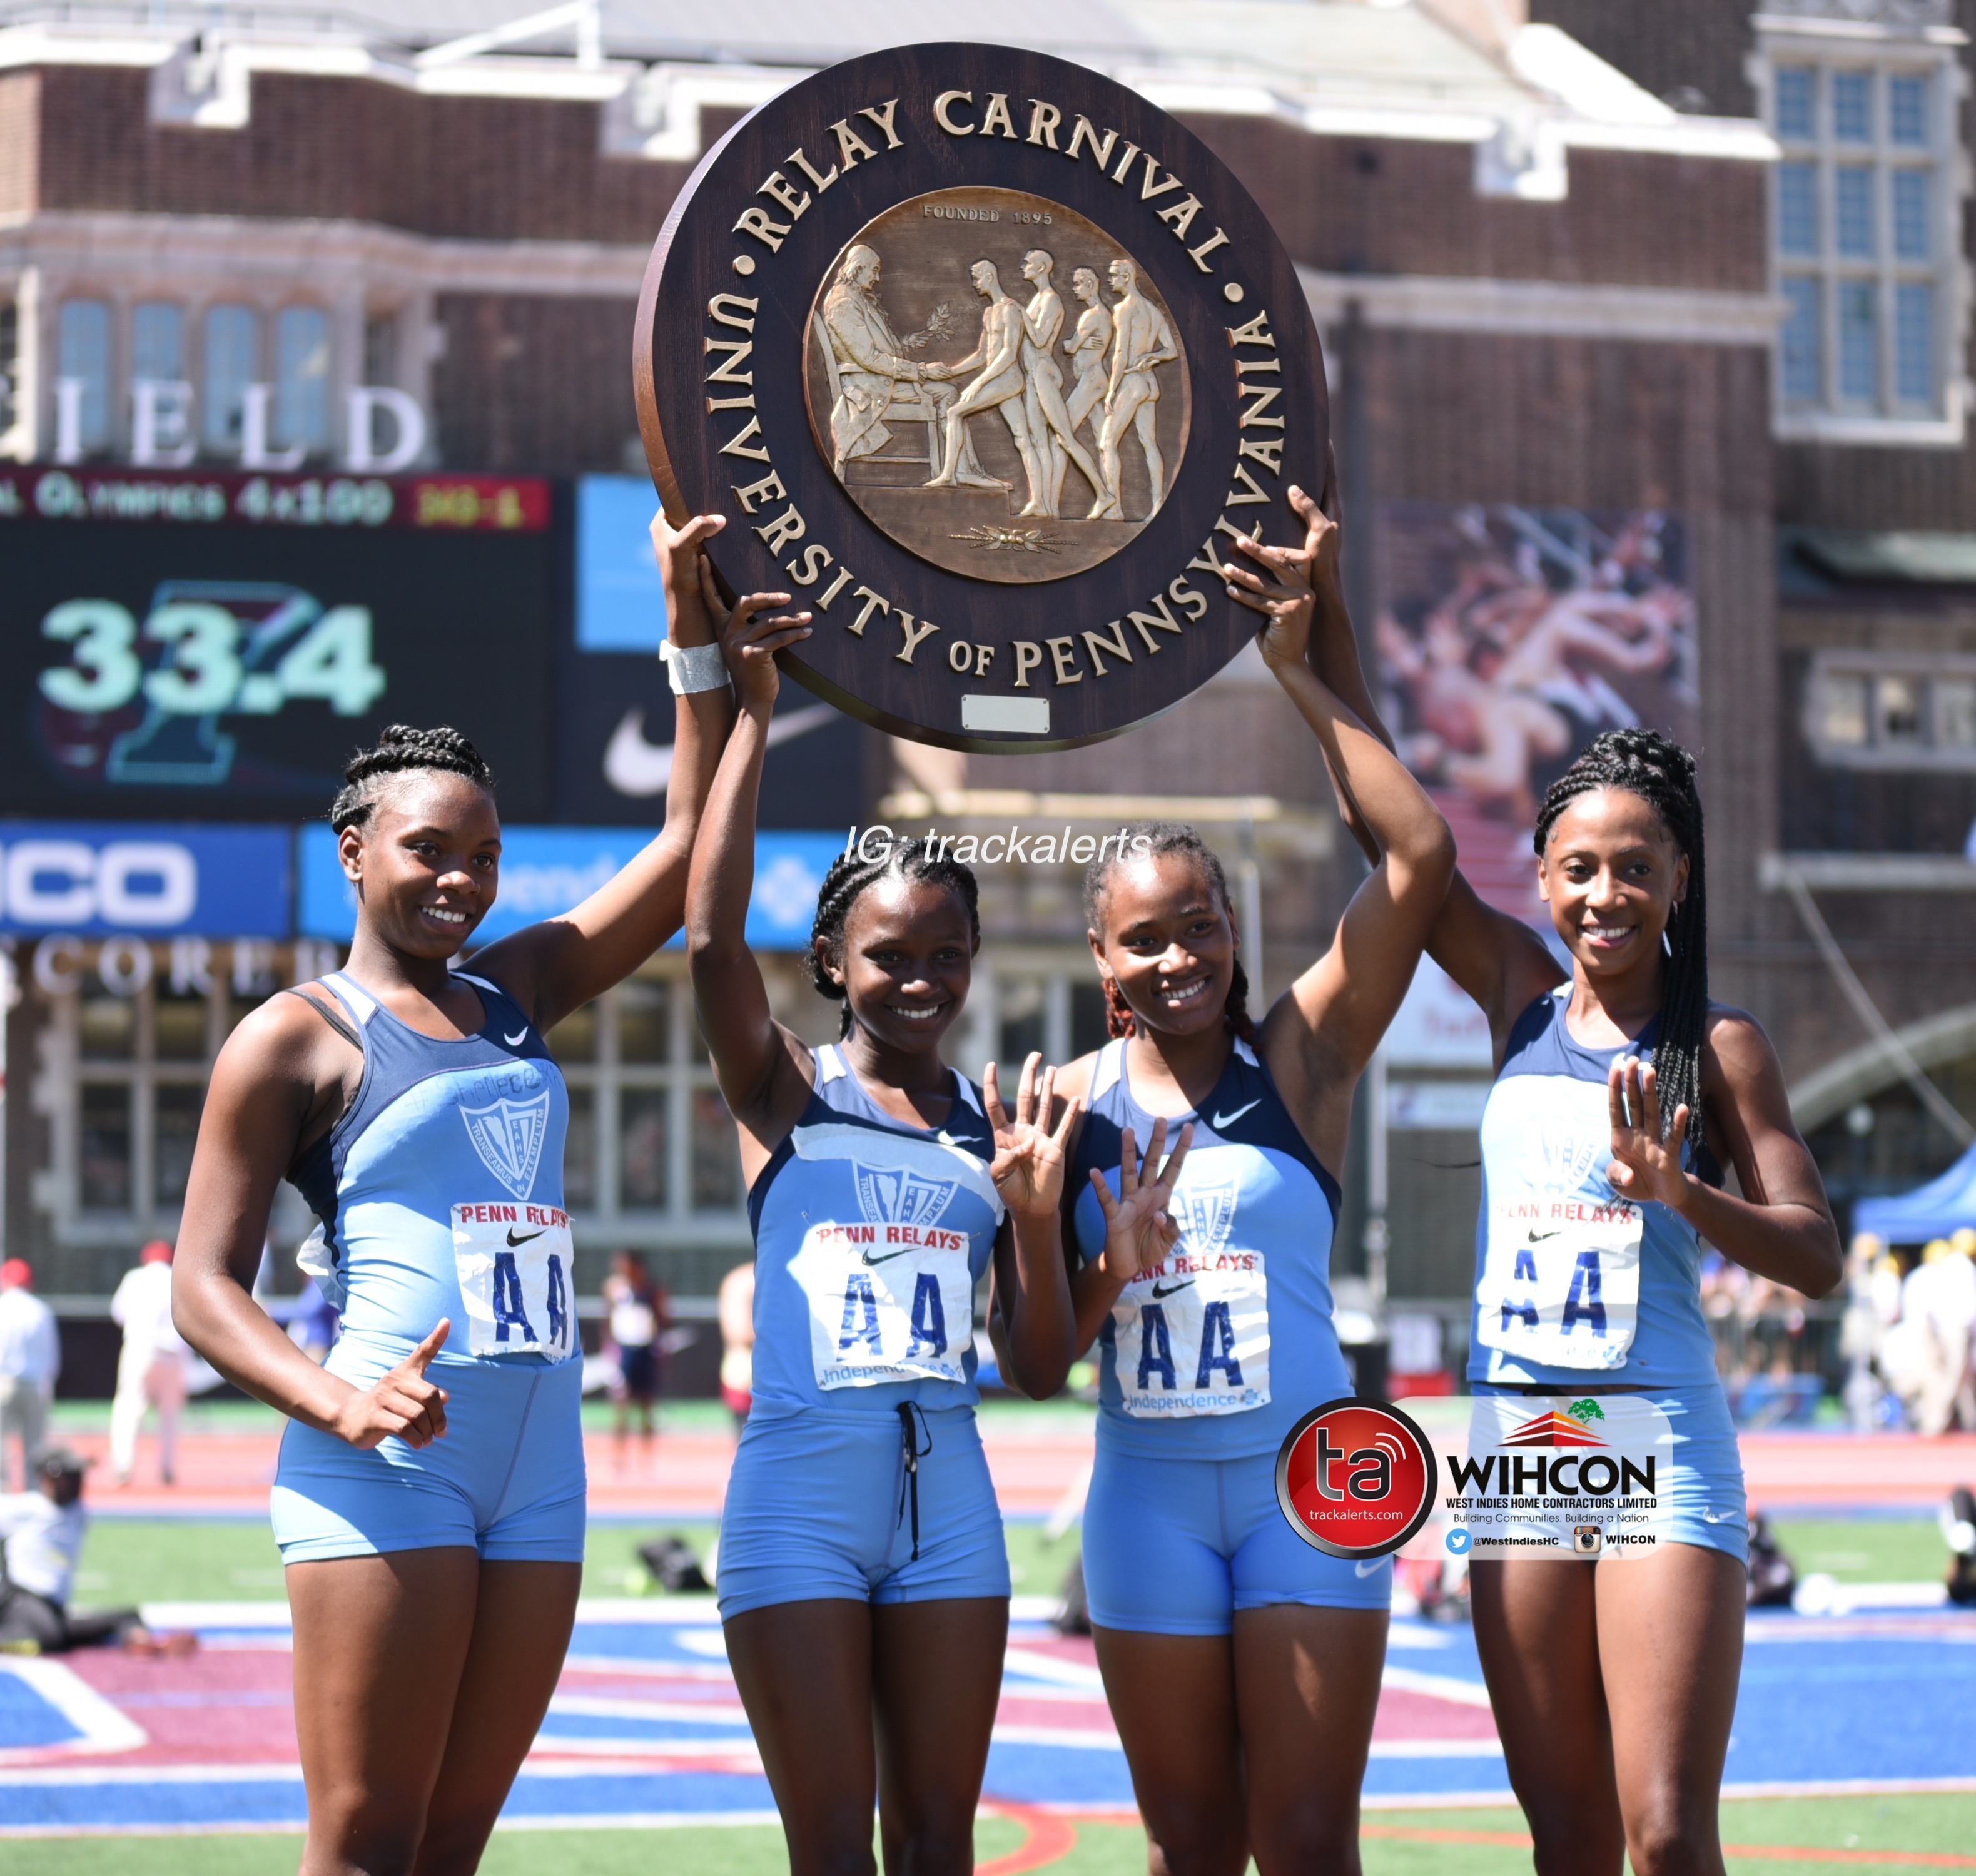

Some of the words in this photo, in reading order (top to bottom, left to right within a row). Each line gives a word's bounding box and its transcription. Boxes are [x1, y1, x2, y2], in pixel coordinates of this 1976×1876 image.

[732, 99, 904, 252] RELAY
[933, 90, 1230, 274] CARNIVAL
[923, 205, 1000, 223] FOUNDED
[1013, 211, 1053, 225] 1895
[54, 378, 428, 473] IELD
[704, 293, 941, 664] UNIVERSITY
[950, 641, 995, 677] OF
[1013, 309, 1285, 687] PENNSYLVANIA
[39, 597, 387, 717] 33.4
[472, 1122, 514, 1184] TRANSEAMUS
[517, 1184, 525, 1194] IN
[524, 1108, 545, 1181] EXEMPLUM
[512, 1120, 524, 1164] EAHS
[461, 1205, 517, 1224] PENN
[859, 1176, 882, 1223] TRANSEA
[919, 1186, 950, 1226] MPLUM
[1550, 1203, 1633, 1225] RELAYS
[819, 1226, 876, 1244] PENN
[886, 1226, 963, 1251] RELAYS
[1132, 1261, 1167, 1284] ENN
[1174, 1254, 1257, 1274] RELAYS
[823, 1362, 937, 1384] Independce
[1129, 1392, 1237, 1412] Independence
